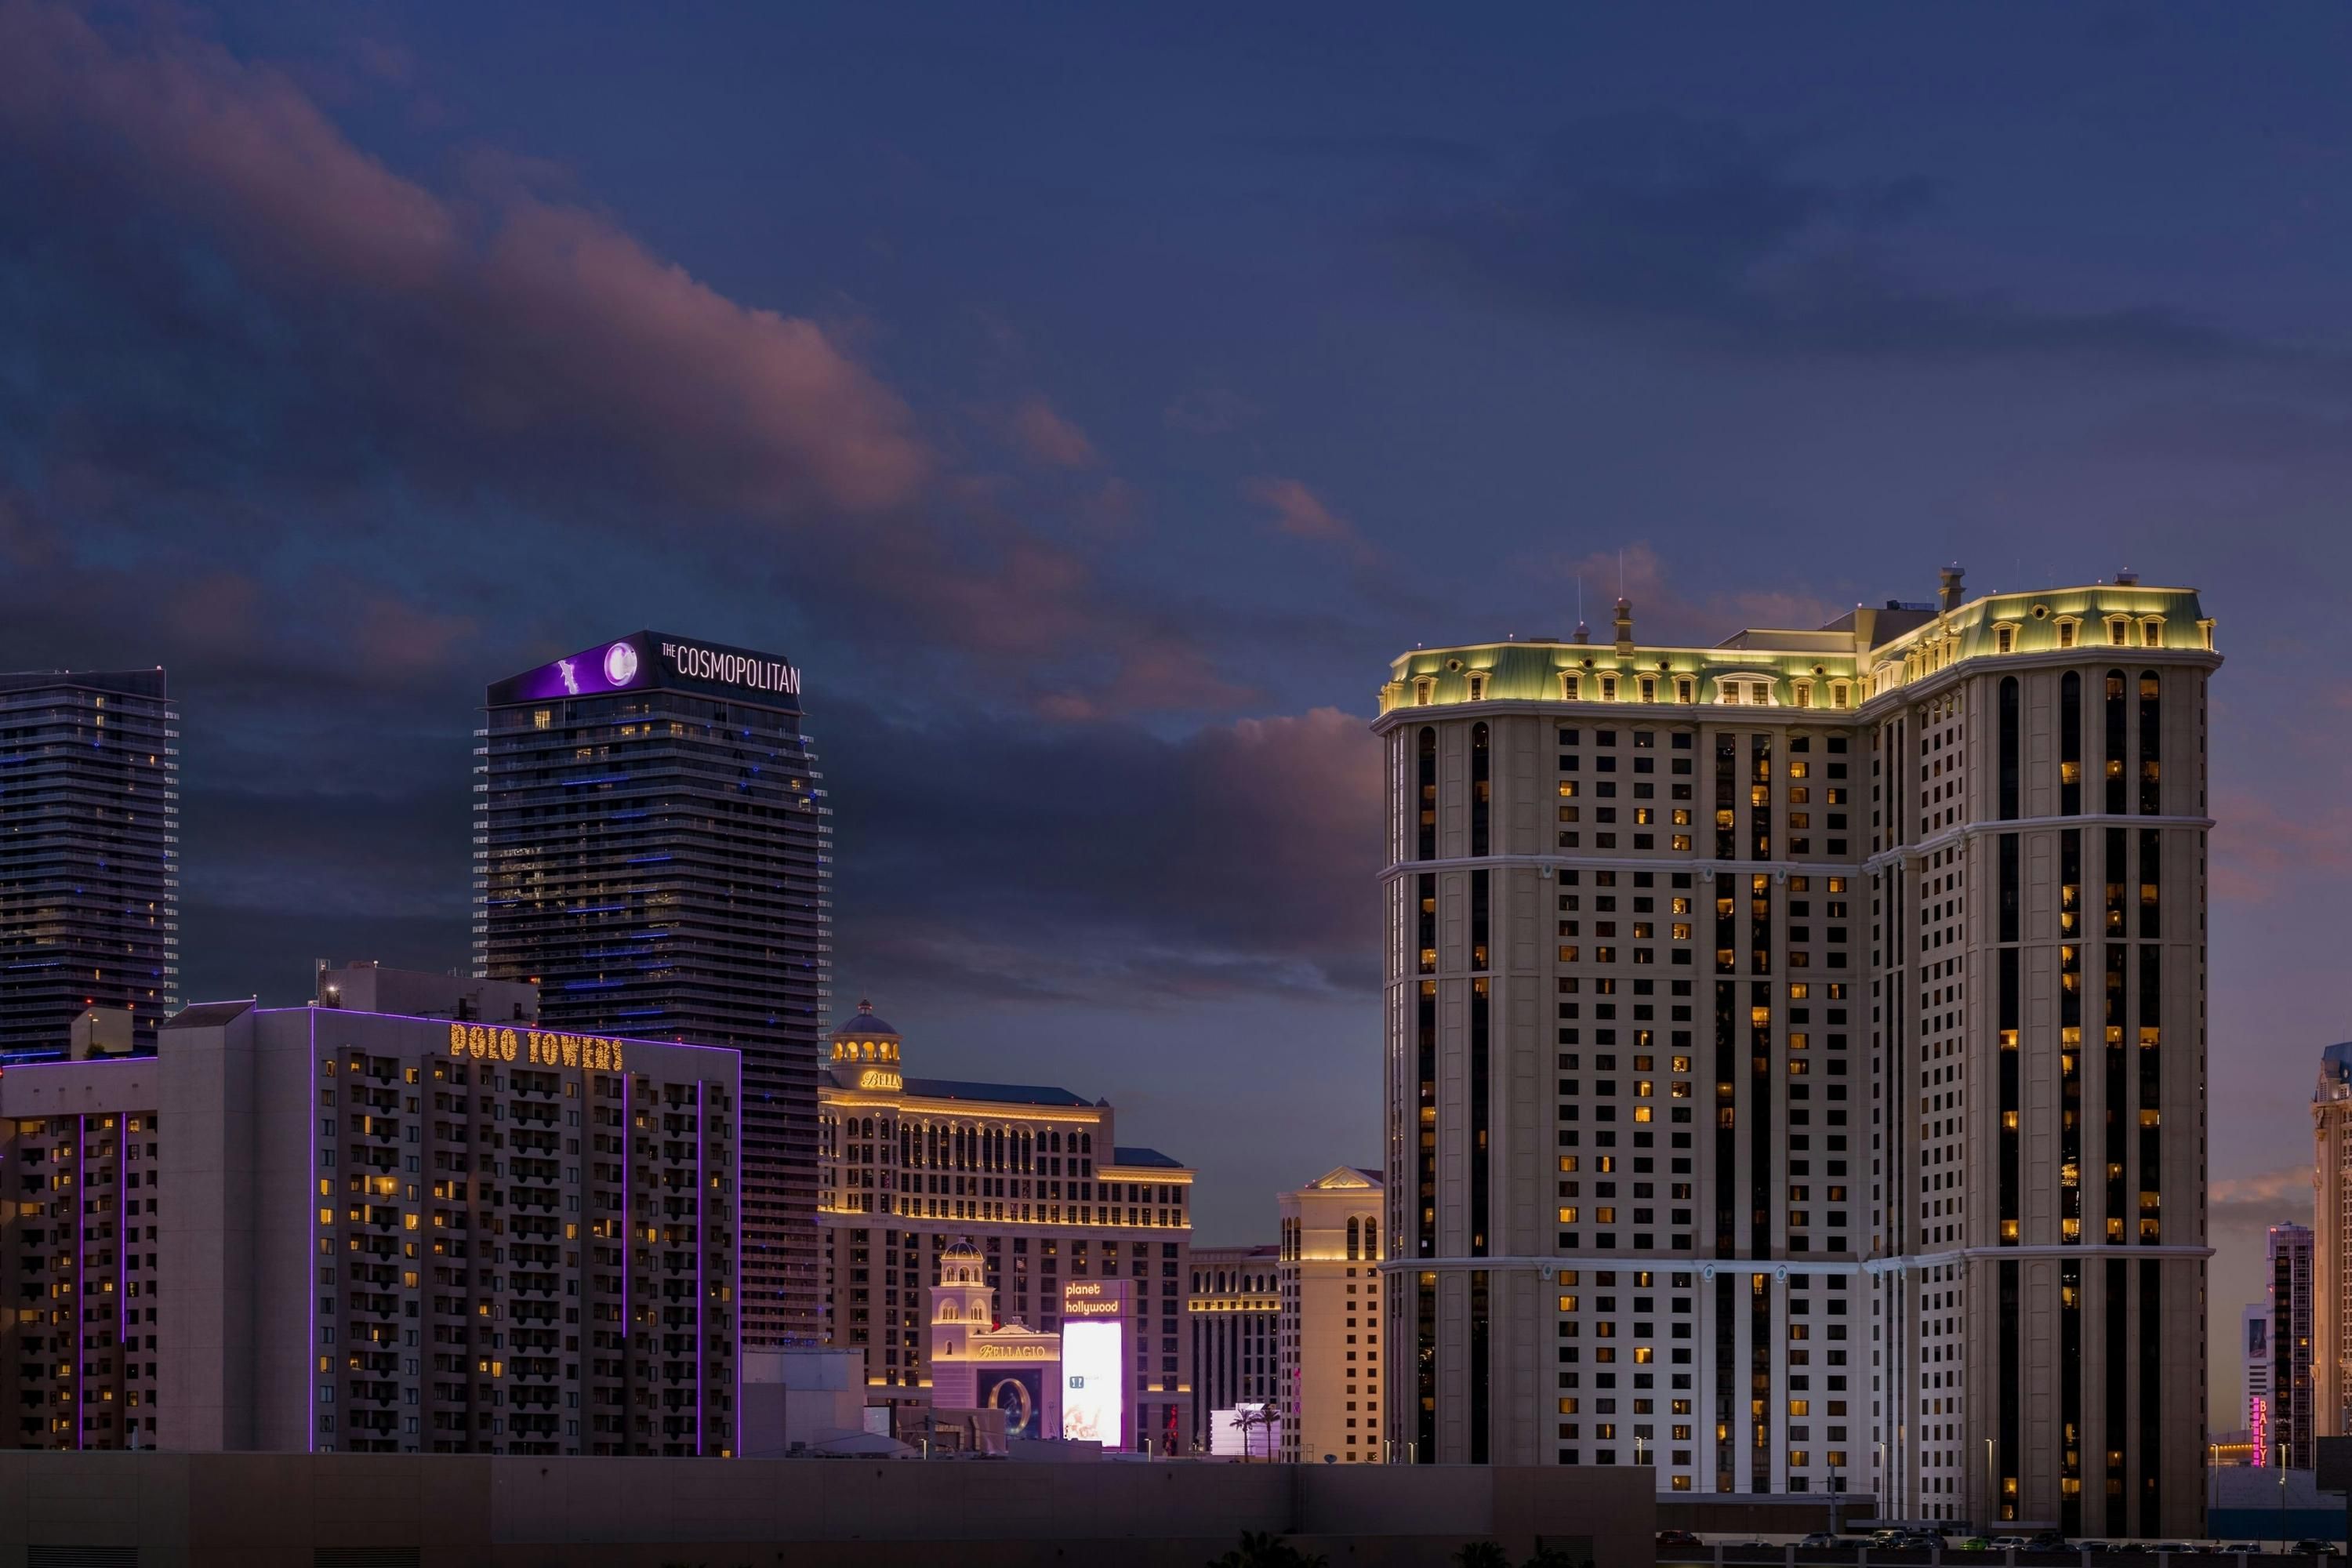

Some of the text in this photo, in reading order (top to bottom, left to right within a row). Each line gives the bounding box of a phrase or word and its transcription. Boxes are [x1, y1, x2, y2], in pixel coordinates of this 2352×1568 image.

[662, 642, 800, 695] THE COSMOPOLITAN
[450, 1023, 622, 1072] POLO TOWERS
[1065, 1283, 1100, 1298] planet
[1065, 1301, 1118, 1315] hollywood
[978, 1345, 1045, 1358] BELLAGIO
